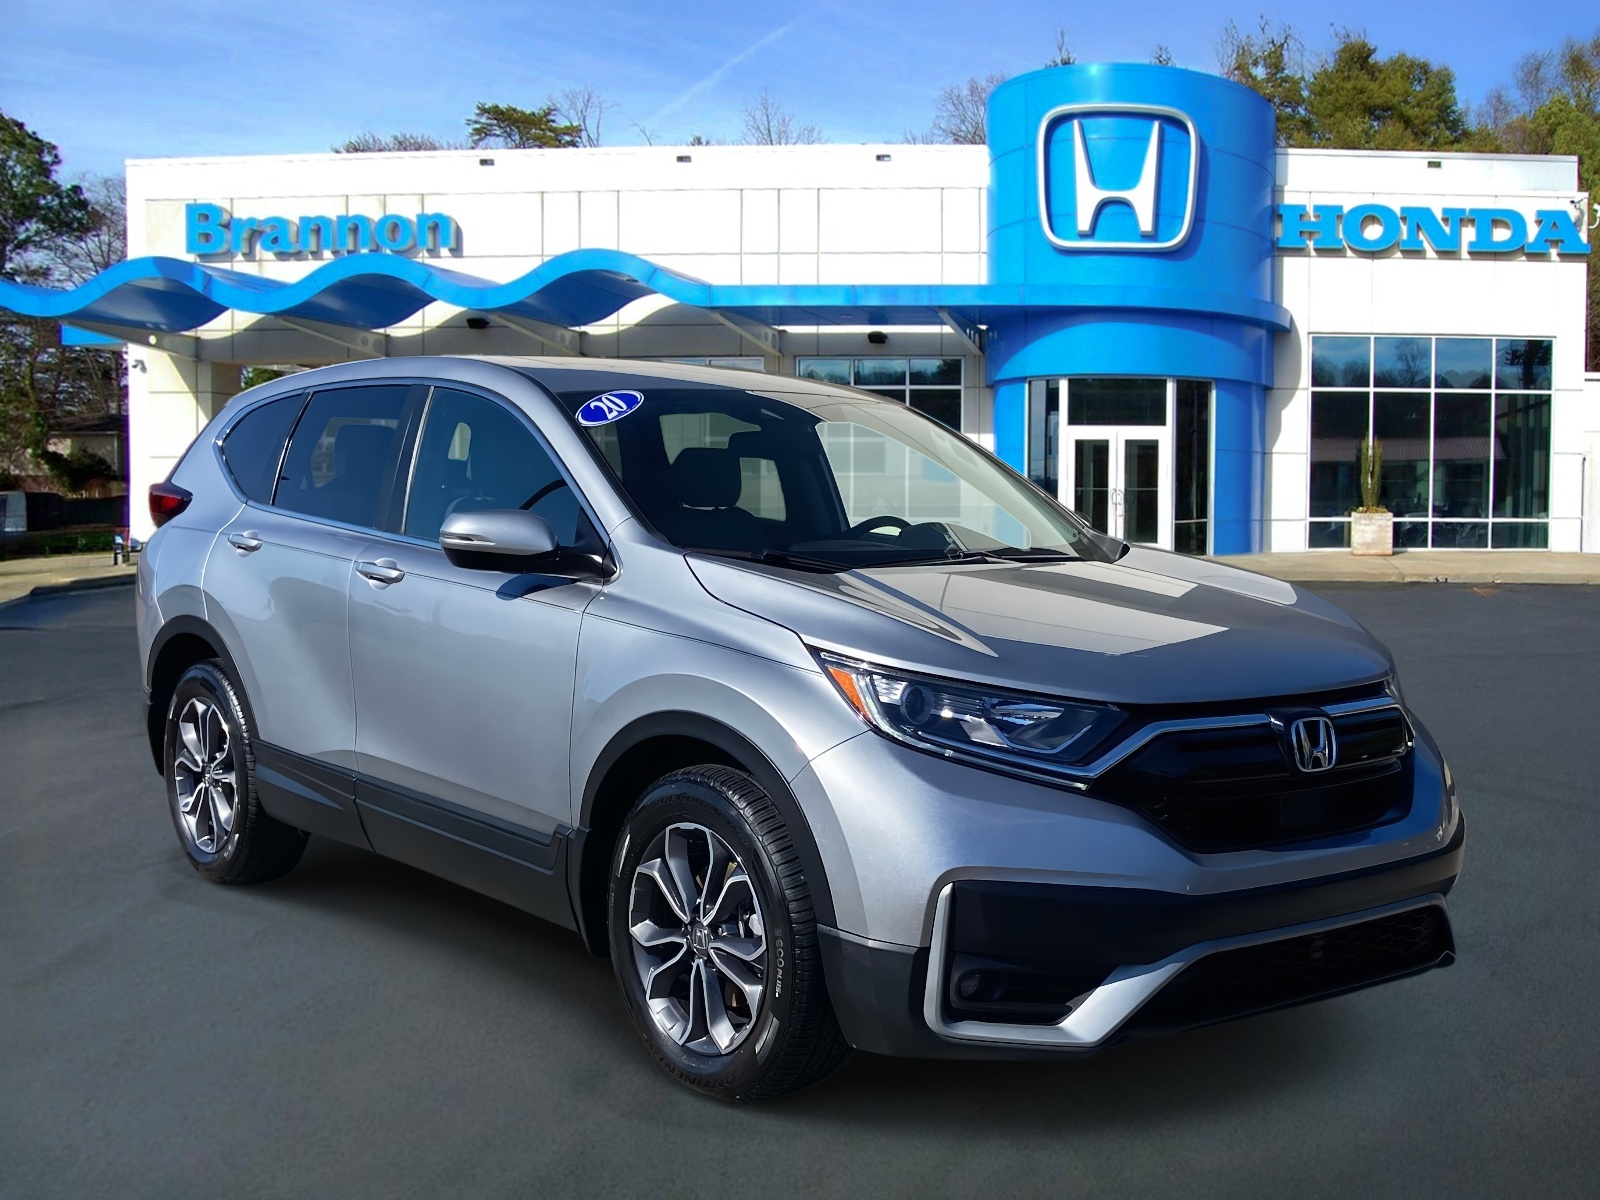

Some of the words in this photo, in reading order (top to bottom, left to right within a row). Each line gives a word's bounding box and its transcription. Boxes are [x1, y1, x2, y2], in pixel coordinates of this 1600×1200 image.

[185, 203, 452, 255] Brannon
[1276, 203, 1592, 255] HONDA
[589, 394, 628, 420] 20
